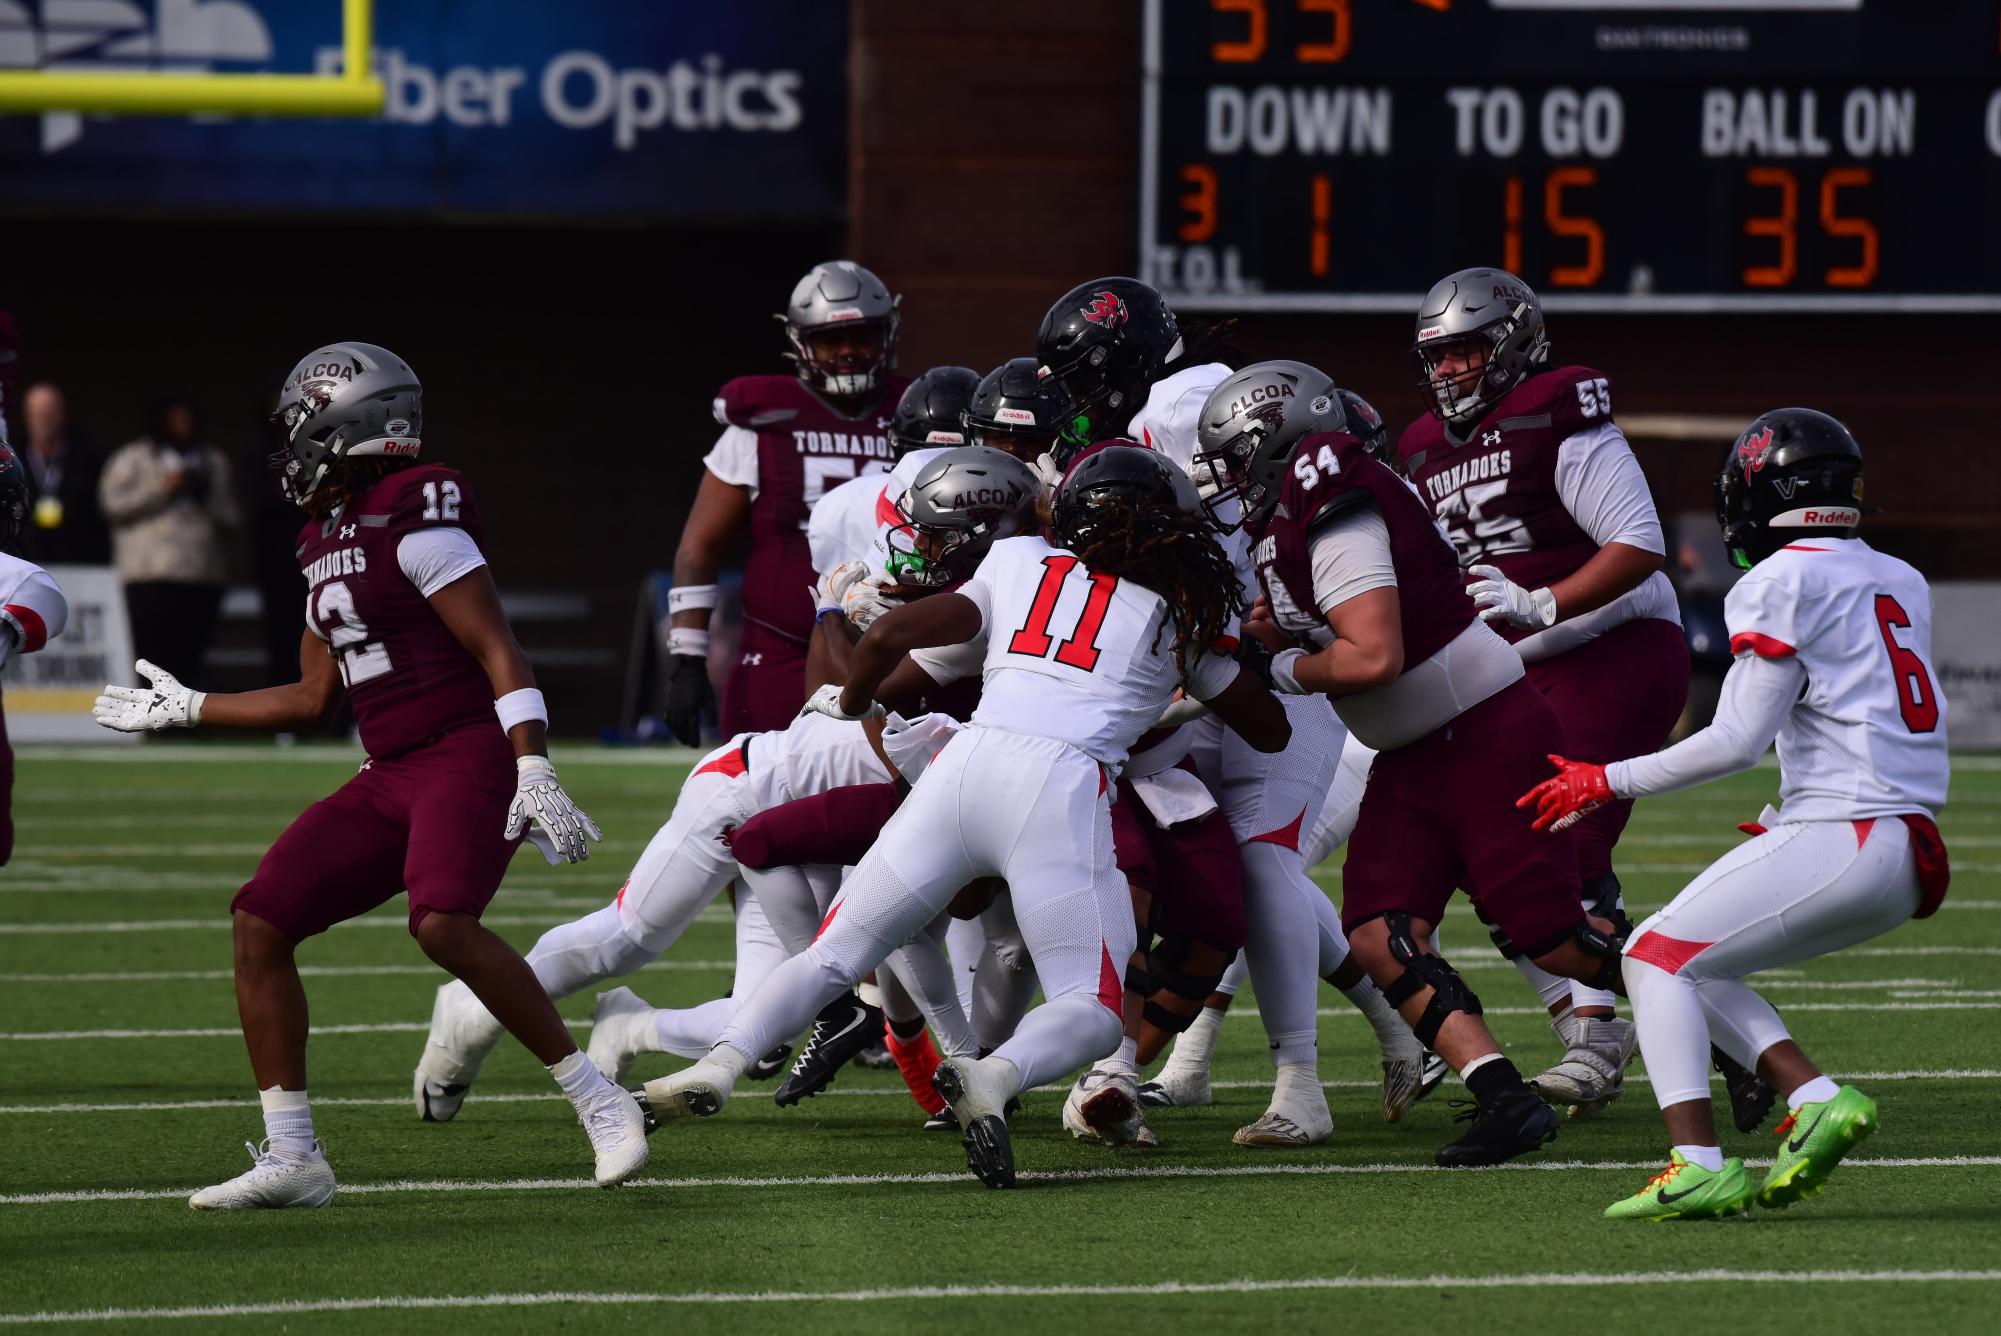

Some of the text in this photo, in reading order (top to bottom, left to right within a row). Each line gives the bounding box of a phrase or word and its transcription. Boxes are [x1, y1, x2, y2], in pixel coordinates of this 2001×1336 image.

[313, 47, 526, 126] ber
[541, 51, 802, 150] Optics
[1206, 86, 1391, 156] DOWN
[1447, 88, 1625, 157] TO GO
[1702, 88, 1830, 157] BALL
[1842, 88, 1916, 157] ON
[1178, 163, 1218, 242] 3
[1310, 172, 1332, 279] 1
[1504, 167, 1606, 288] 15
[1743, 166, 1880, 287] 35
[293, 362, 353, 387] ALCOA
[1229, 383, 1296, 418] ALCOA
[1575, 377, 1610, 418] 55
[792, 430, 897, 459] TORNADO
[1294, 444, 1342, 491] 54
[1426, 449, 1512, 502] TORNADOES
[421, 480, 462, 521] 12
[953, 488, 1019, 511] ALCOA
[1434, 478, 1536, 568] 55
[1803, 510, 1858, 524] Riddell
[301, 546, 367, 591] RNADOES
[1007, 554, 1119, 673] 11
[1873, 593, 1939, 734] 6
